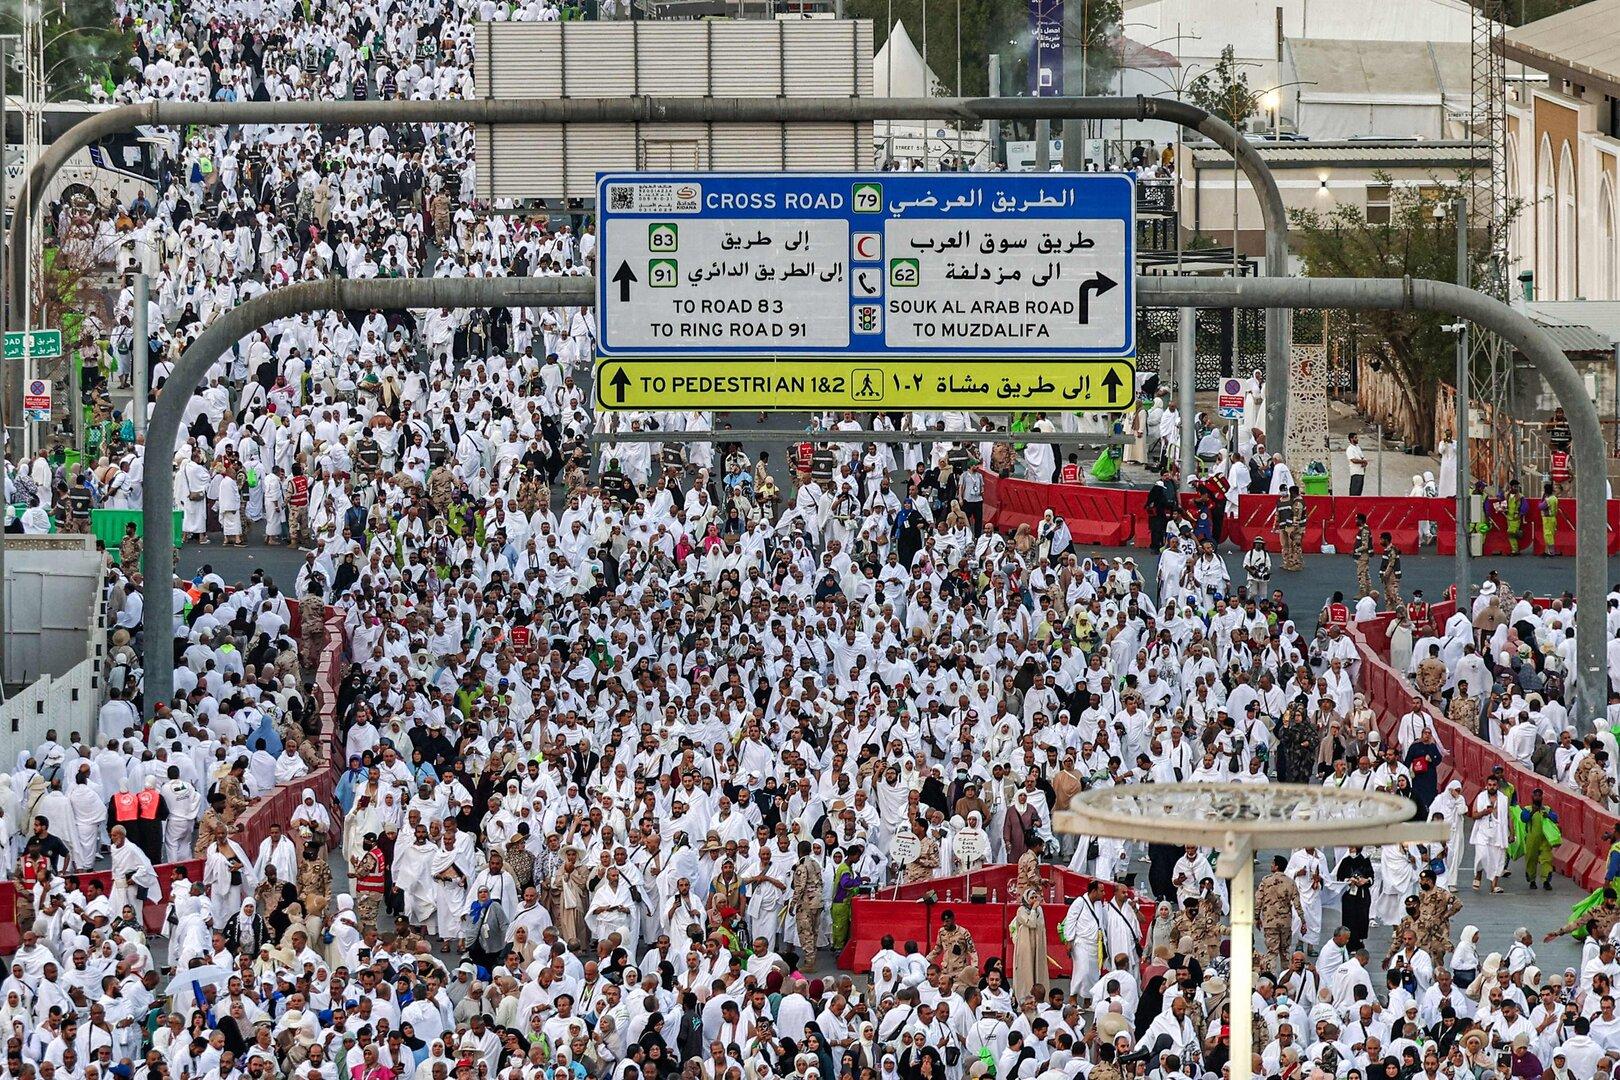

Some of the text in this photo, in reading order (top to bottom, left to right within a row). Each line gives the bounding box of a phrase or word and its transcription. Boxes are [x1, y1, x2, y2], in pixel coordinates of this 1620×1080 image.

[706, 192, 844, 209] CROSS ROAD
[857, 194, 878, 208] 79
[888, 188, 1075, 218] الطريق العرضي
[652, 233, 674, 247] 83
[720, 230, 810, 251] إلى طريق
[910, 230, 1096, 254] طريق سوق العرب
[654, 269, 673, 283] 91
[687, 261, 843, 287] إلى الطريق الدائري
[894, 268, 915, 282] 62
[944, 262, 1061, 287] الى مزدلفة
[673, 299, 784, 314] TO ROAD 83
[889, 299, 1075, 315] SOUK AL ARAB ROAD
[651, 322, 806, 338] TO RING ROAD 91
[912, 322, 1050, 338] TO MUZDALIFA
[4, 338, 21, 346] OAD
[640, 376, 845, 394] TO PEDESTRIAN 1&2
[936, 374, 990, 395] مشاة
[996, 374, 1056, 399] طريق
[1062, 374, 1091, 400] إلى
